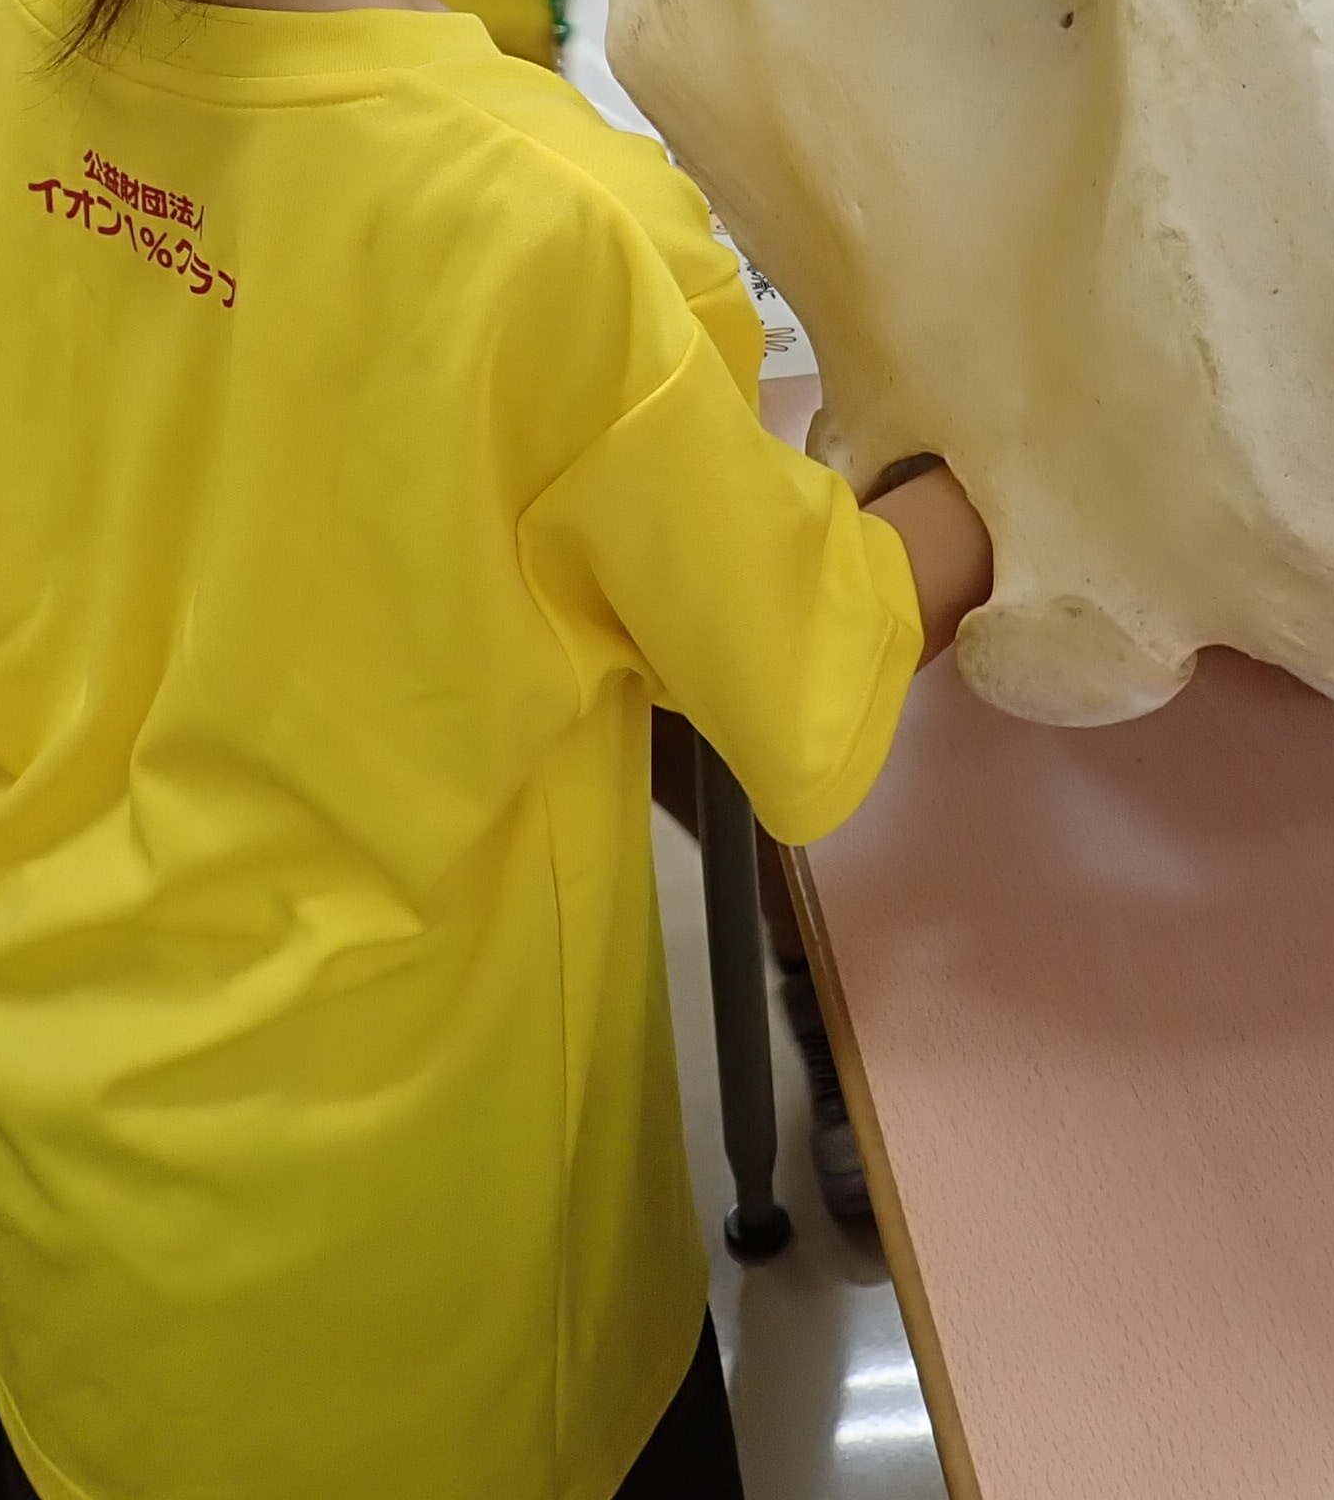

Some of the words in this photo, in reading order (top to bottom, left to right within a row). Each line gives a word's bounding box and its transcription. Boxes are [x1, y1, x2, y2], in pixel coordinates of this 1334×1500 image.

[83, 149, 205, 241] 公益財団法人
